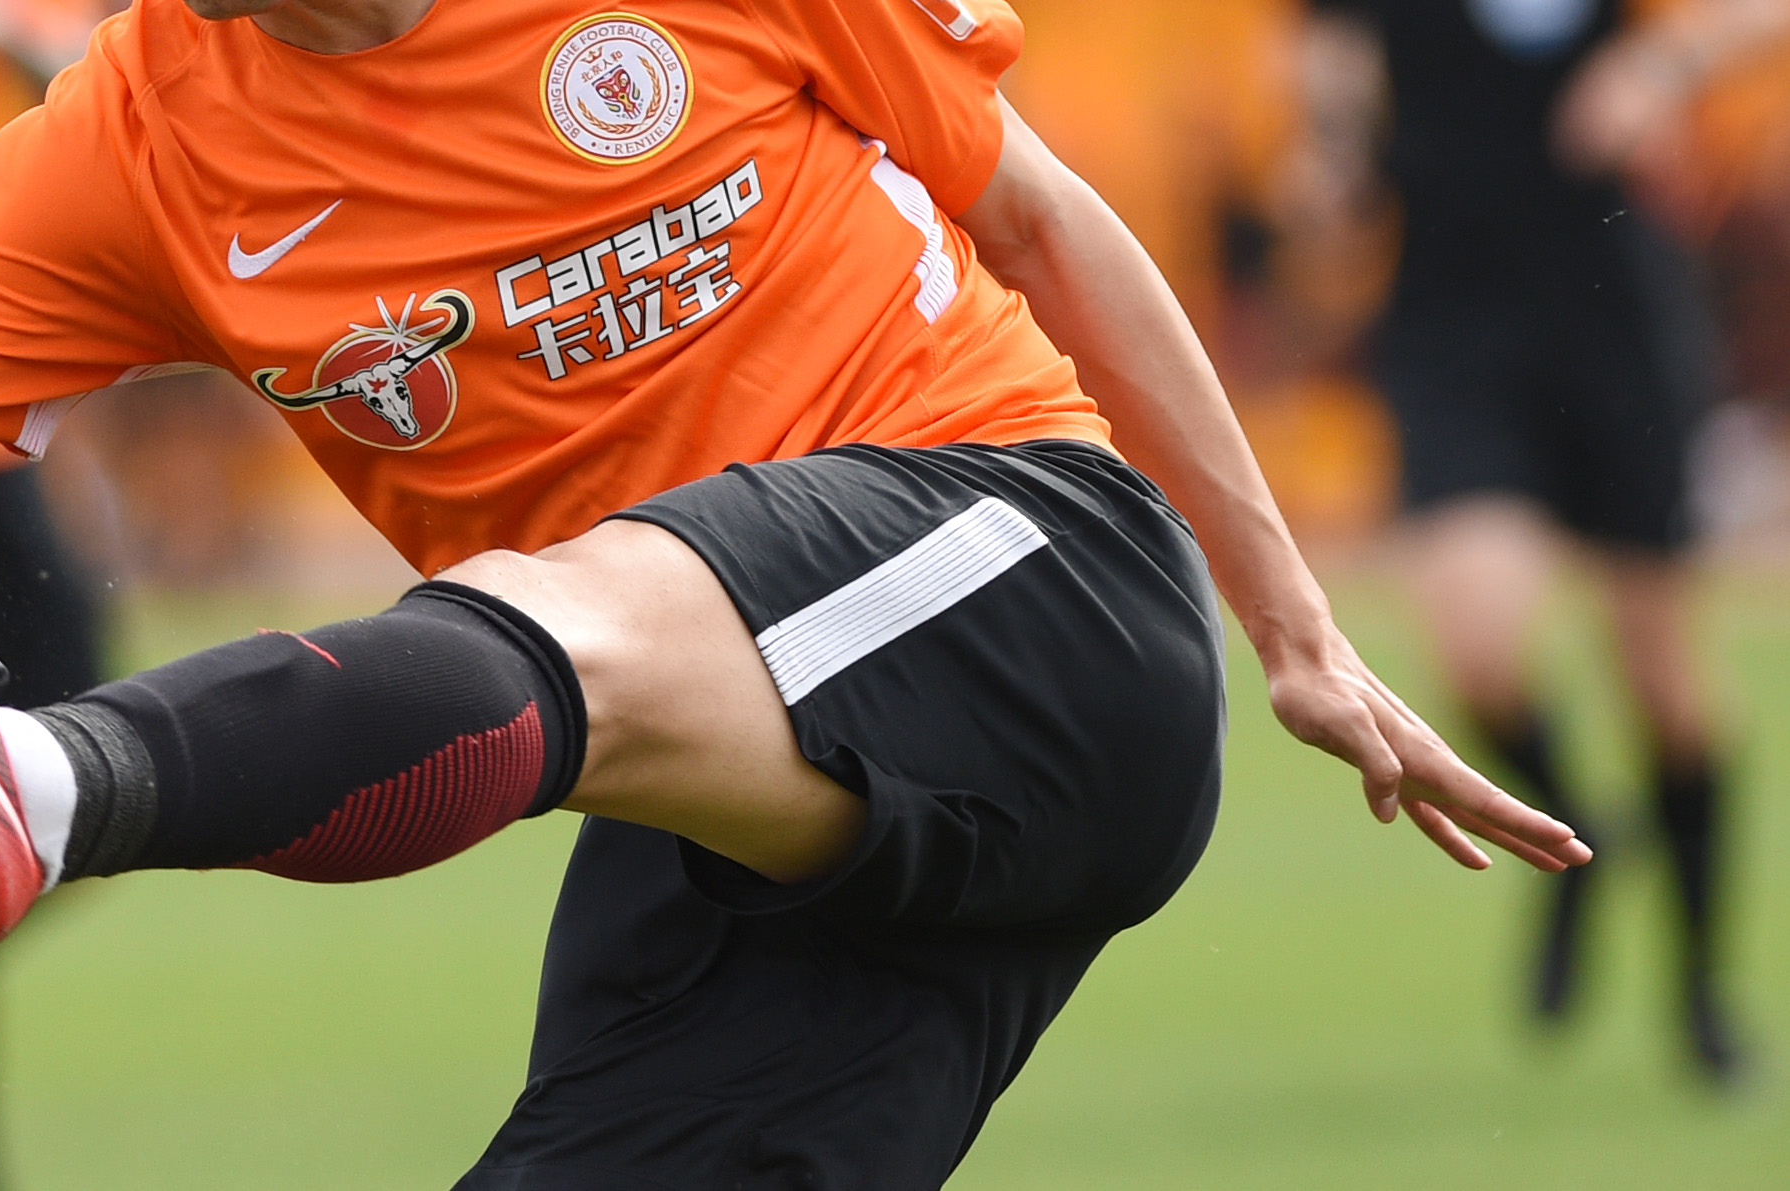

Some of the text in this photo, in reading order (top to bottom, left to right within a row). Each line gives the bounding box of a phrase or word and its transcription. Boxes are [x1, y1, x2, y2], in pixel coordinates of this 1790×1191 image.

[579, 24, 647, 45] FOOTBALL
[650, 38, 678, 72] CLUB
[551, 42, 580, 84] RENHE
[581, 50, 623, 83] 北京人和
[550, 89, 580, 139] BEIJING
[614, 127, 666, 155] RENHE
[665, 105, 680, 126] FC
[495, 157, 763, 327] Carabao
[517, 241, 743, 380] 卡拉宝
